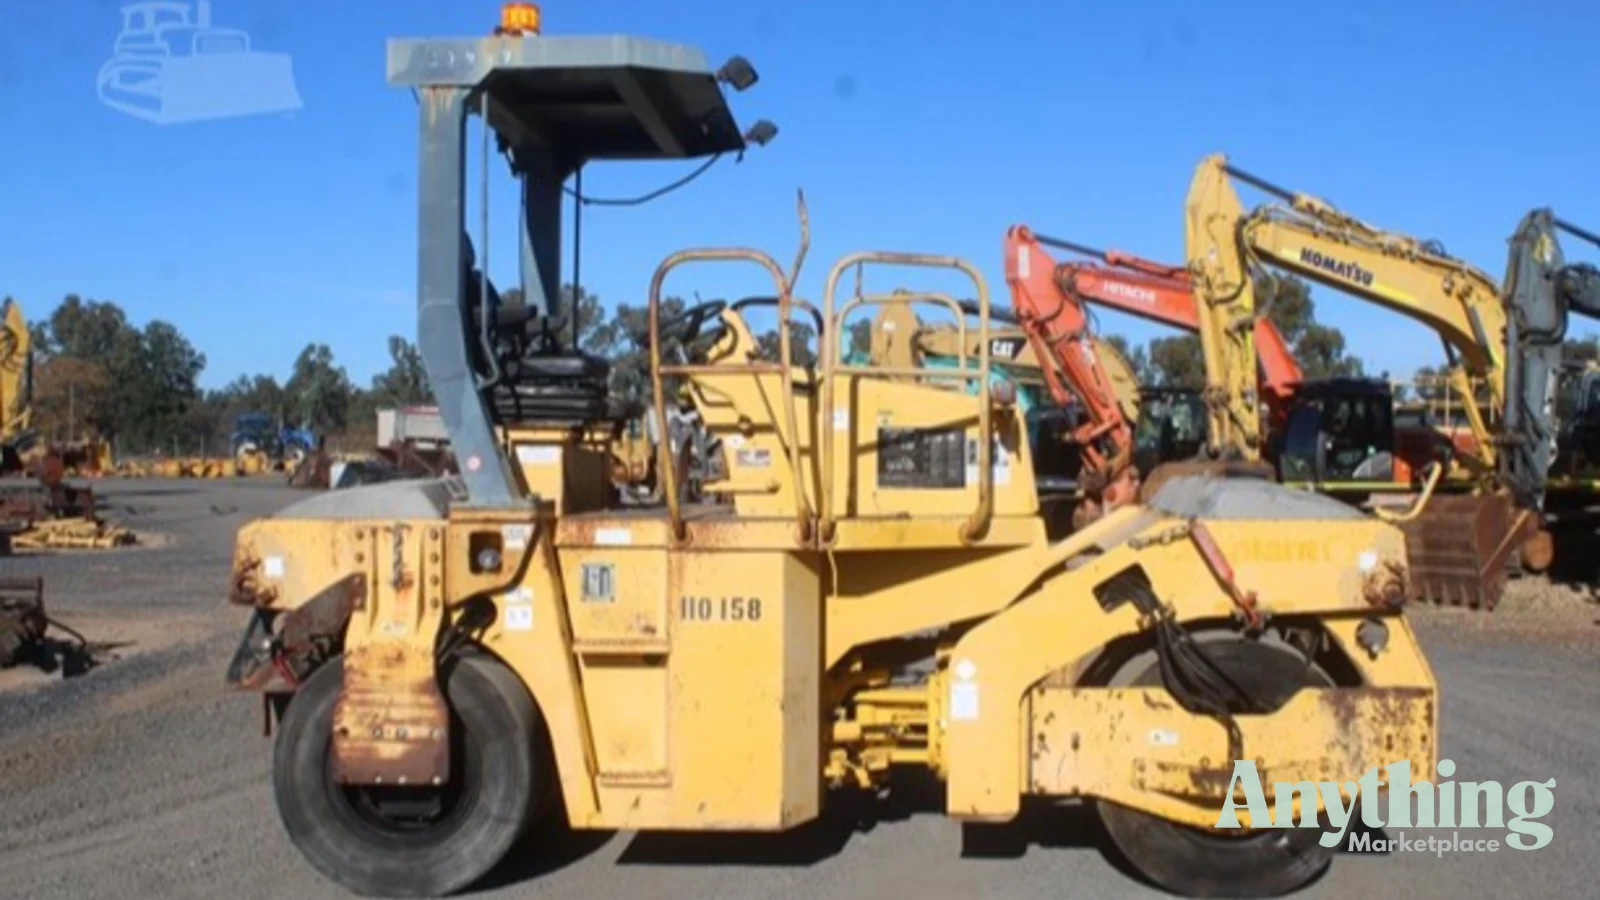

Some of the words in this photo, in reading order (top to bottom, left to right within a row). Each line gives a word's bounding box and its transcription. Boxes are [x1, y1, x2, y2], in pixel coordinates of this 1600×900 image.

[1301, 246, 1374, 286] KOMATSU
[1103, 280, 1156, 304] HITACHI
[992, 340, 1014, 357] CAT
